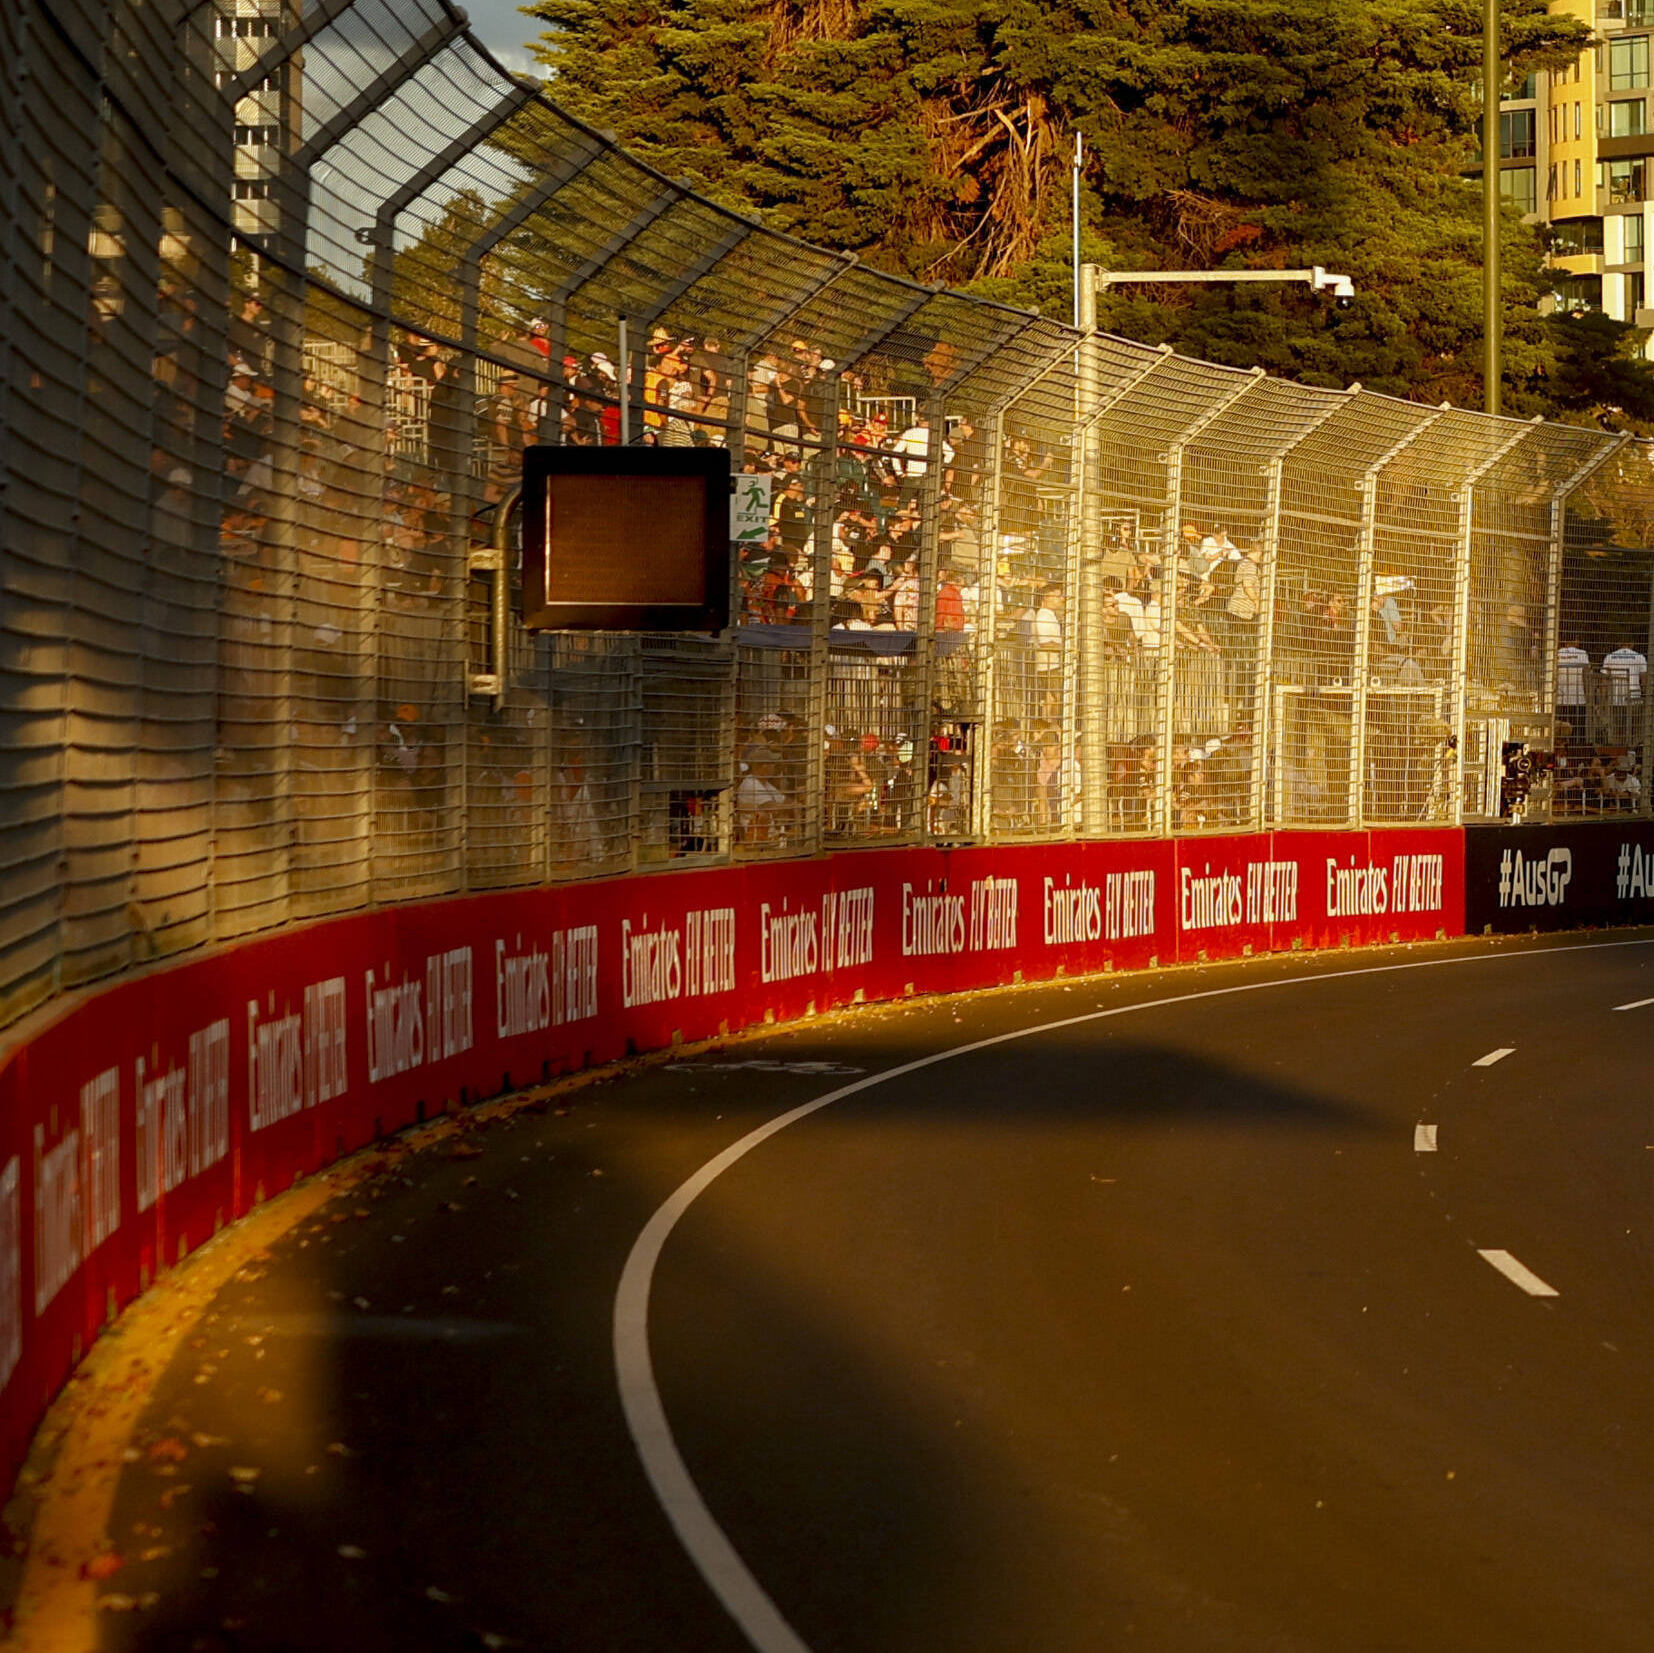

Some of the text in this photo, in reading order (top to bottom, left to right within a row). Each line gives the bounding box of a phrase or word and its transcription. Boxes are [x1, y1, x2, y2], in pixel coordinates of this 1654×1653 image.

[736, 514, 769, 523] EXIT
[1044, 870, 1155, 945] Emirates FLY BETTER
[1181, 861, 1298, 930] Emirates FLY BETTER
[1326, 854, 1443, 917] Emirates FLY BETTER
[1499, 849, 1571, 907] #AusGP
[761, 887, 874, 984] Emirates FLY BETTER
[902, 878, 965, 956] Emirates
[622, 912, 681, 1008] Emirates
[703, 907, 735, 995] BETTER
